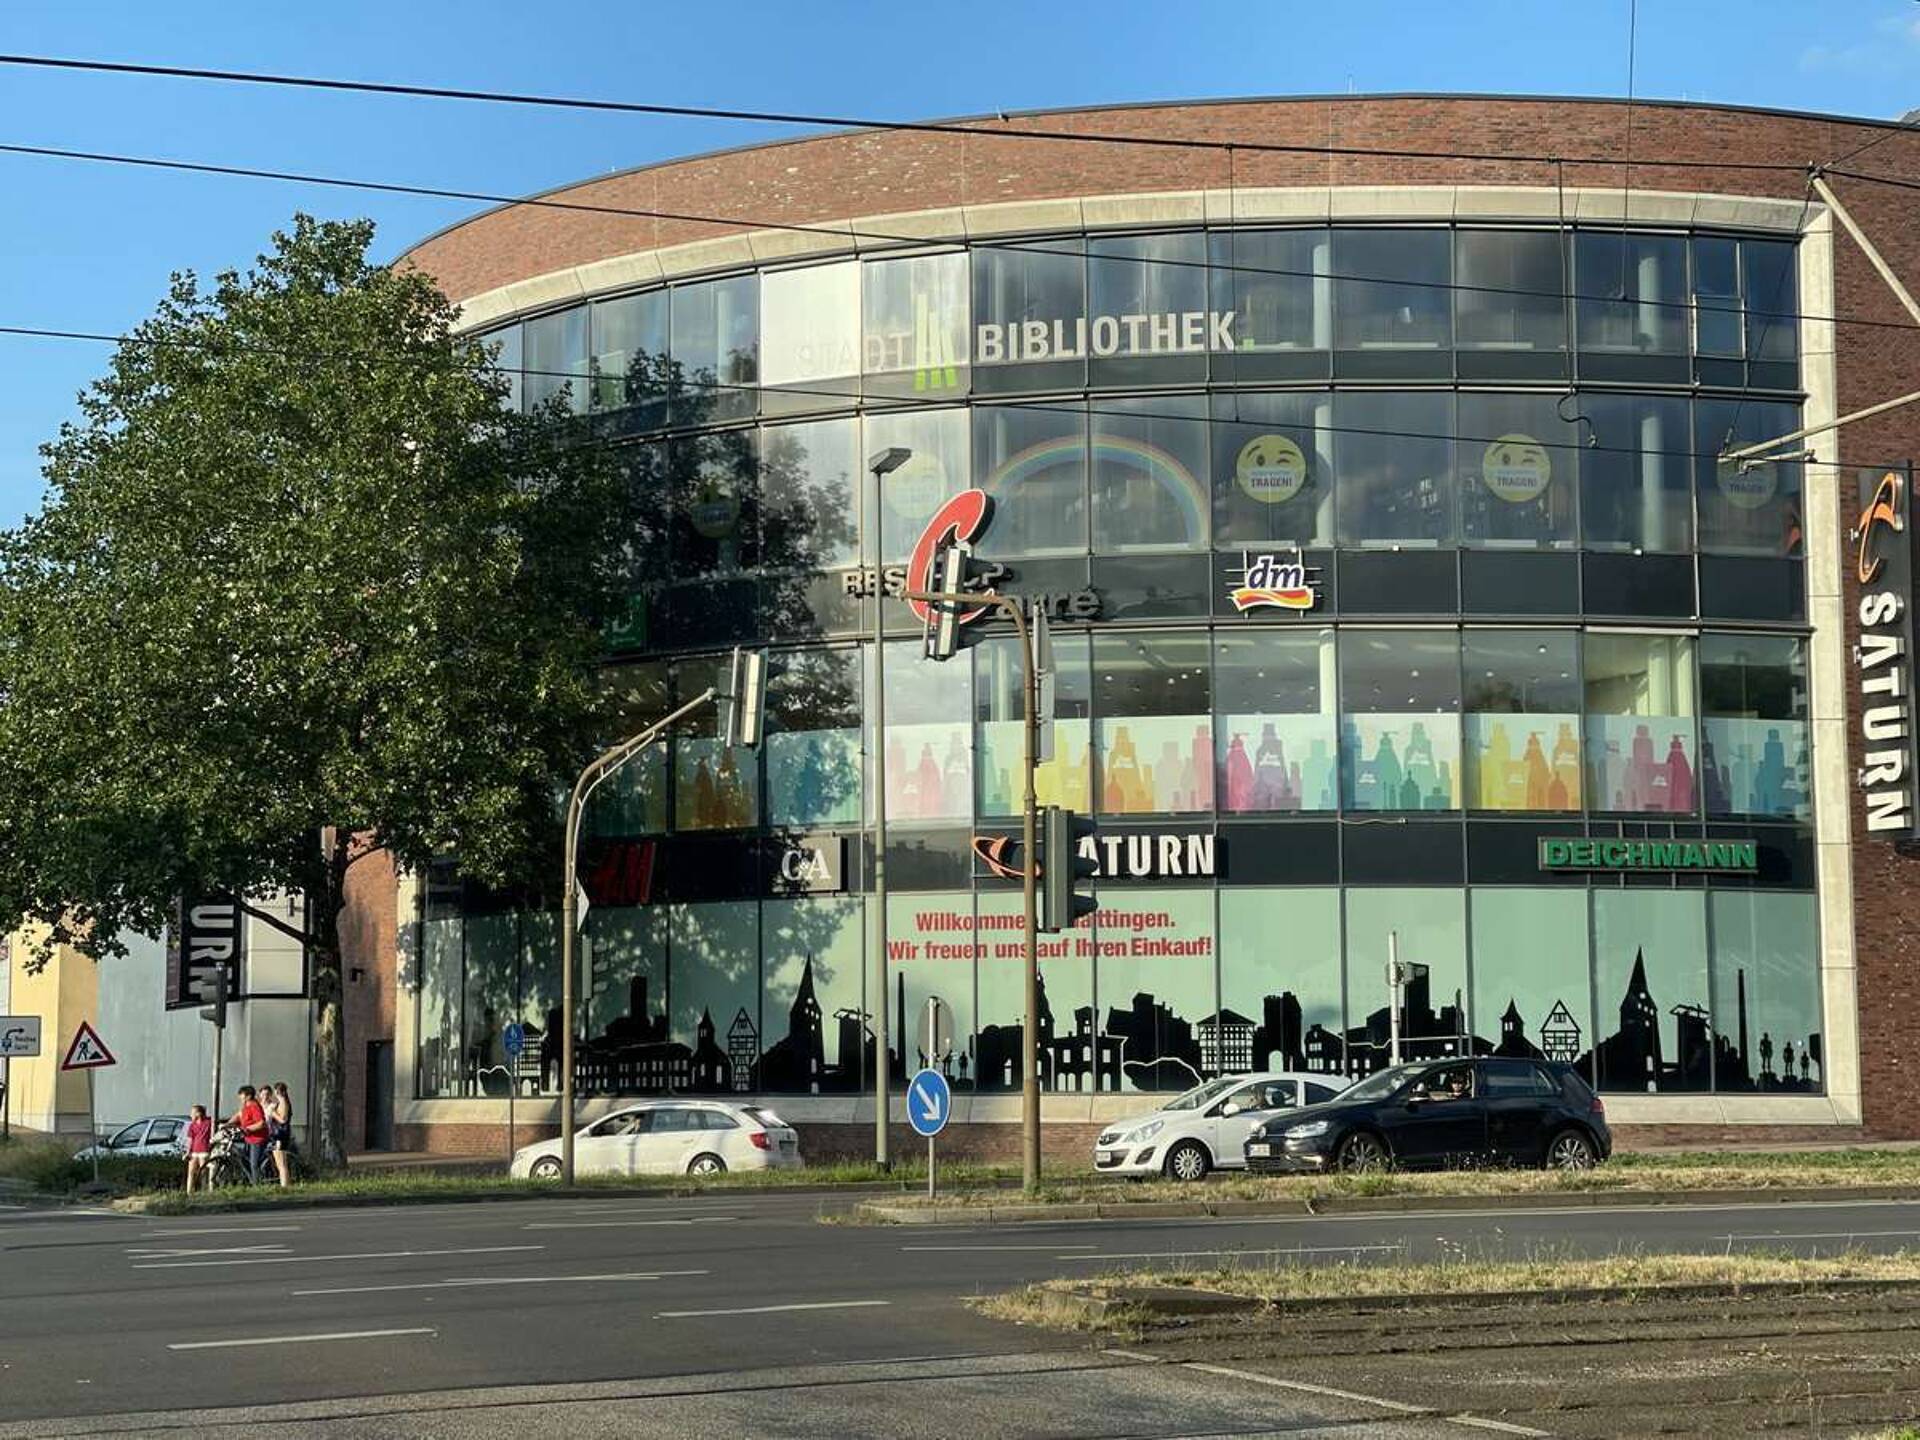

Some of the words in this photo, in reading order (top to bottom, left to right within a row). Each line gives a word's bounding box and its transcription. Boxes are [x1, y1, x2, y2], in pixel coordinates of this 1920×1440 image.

[1248, 556, 1303, 590] dm
[1859, 591, 1906, 831] SATURN
[1078, 834, 1214, 876] ATURN
[1545, 840, 1757, 868] DEICHMANN
[916, 912, 1028, 931] Willkomme
[1072, 909, 1176, 932] attingen.
[888, 941, 919, 960] Wir
[925, 940, 988, 959] freuen
[1038, 938, 1070, 958] auf
[1076, 938, 1127, 957] Ihren
[1131, 936, 1212, 957] Einkauf!
